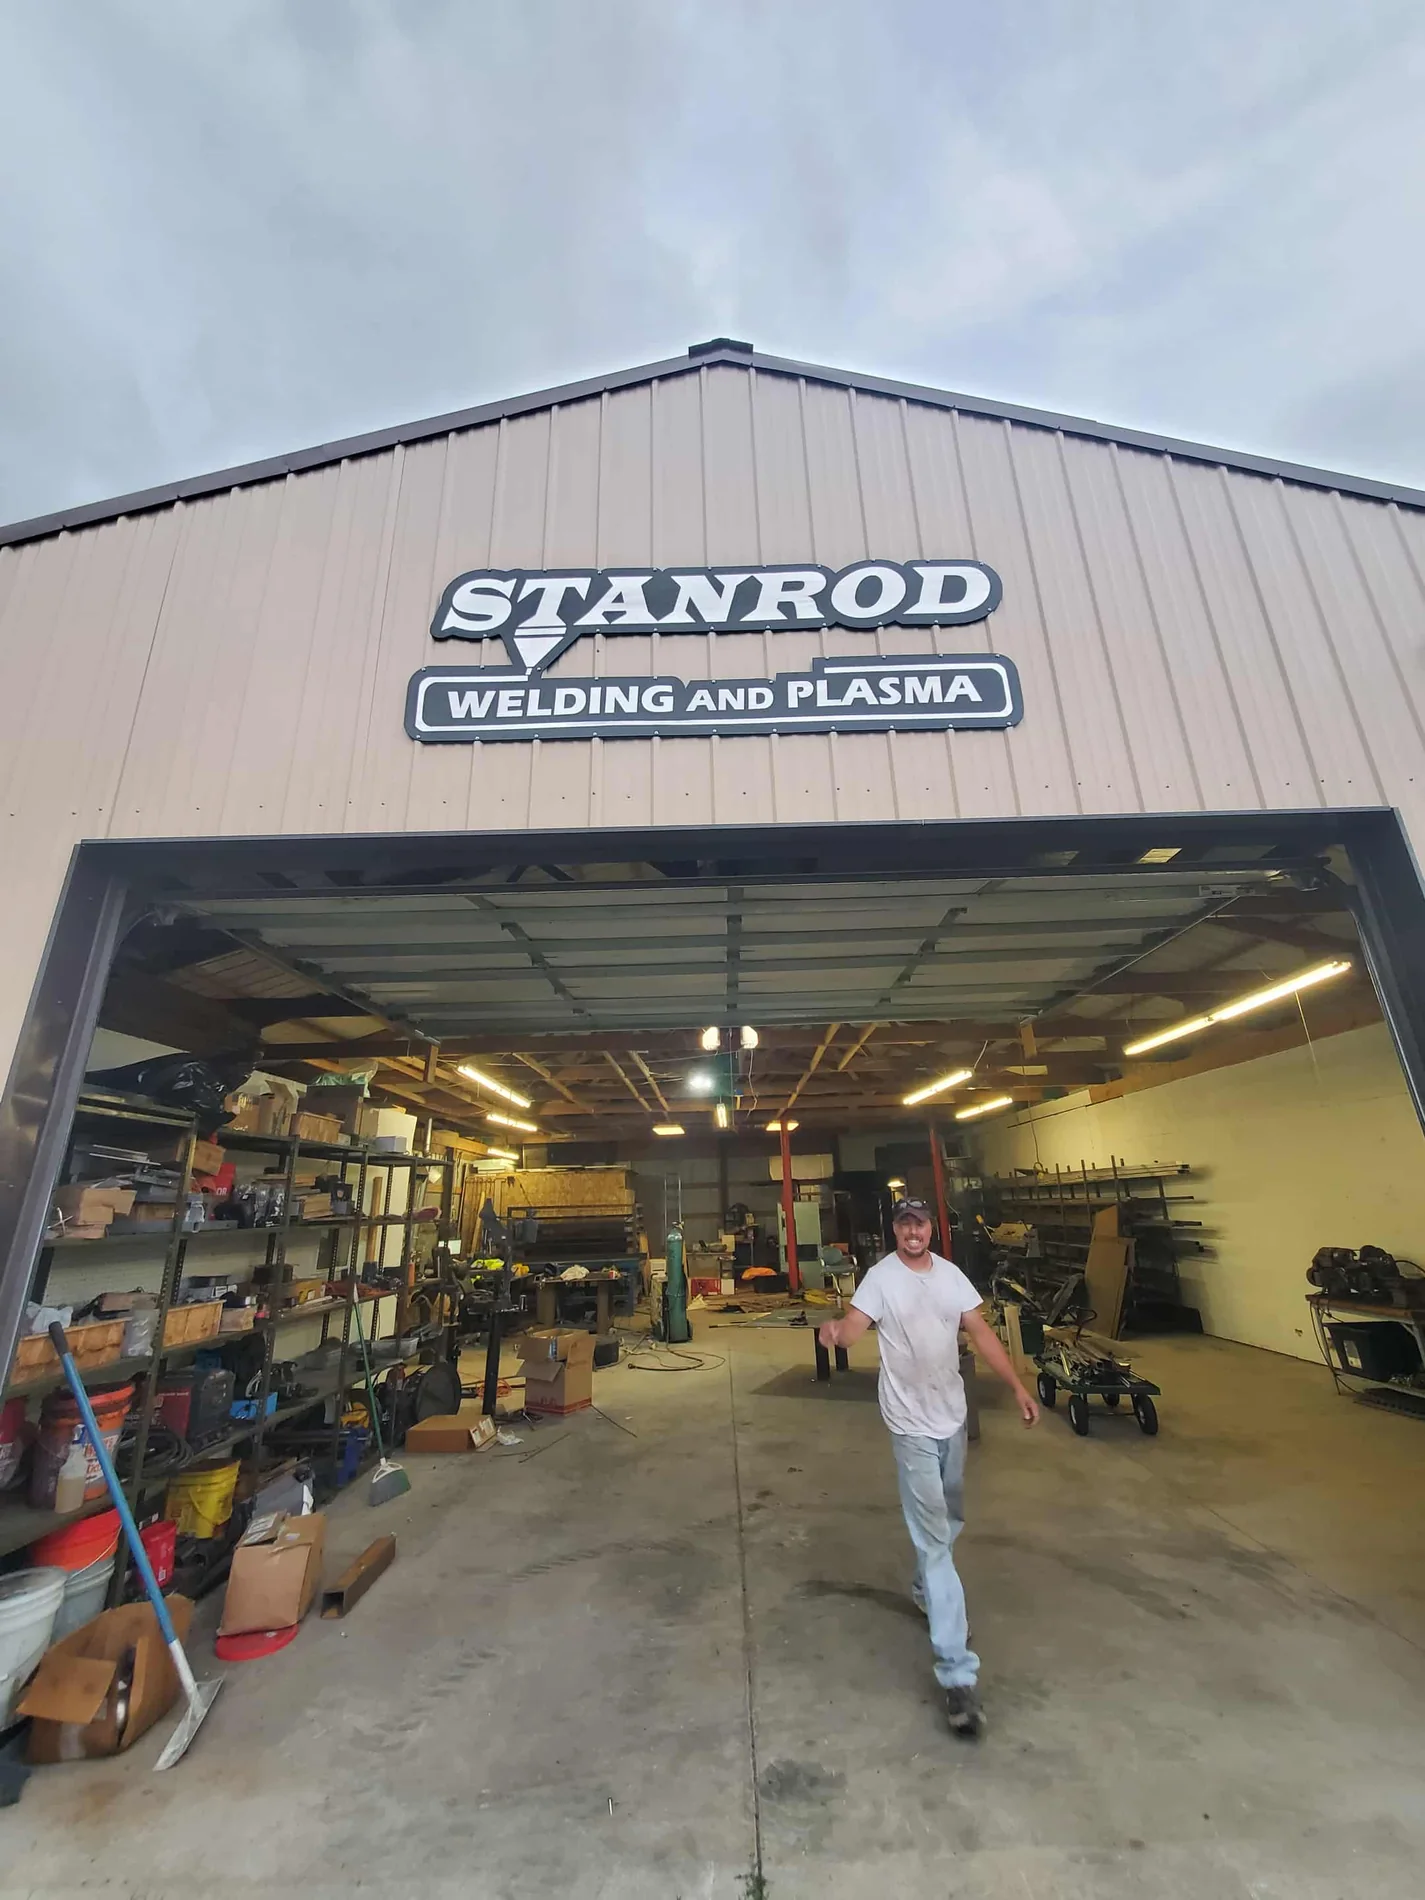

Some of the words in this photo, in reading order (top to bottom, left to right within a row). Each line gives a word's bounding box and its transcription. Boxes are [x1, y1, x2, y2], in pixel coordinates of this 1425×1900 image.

[441, 566, 991, 631] STANROD
[448, 685, 674, 718] WELDING
[685, 687, 774, 711] AND
[788, 675, 983, 708] PLASMA
